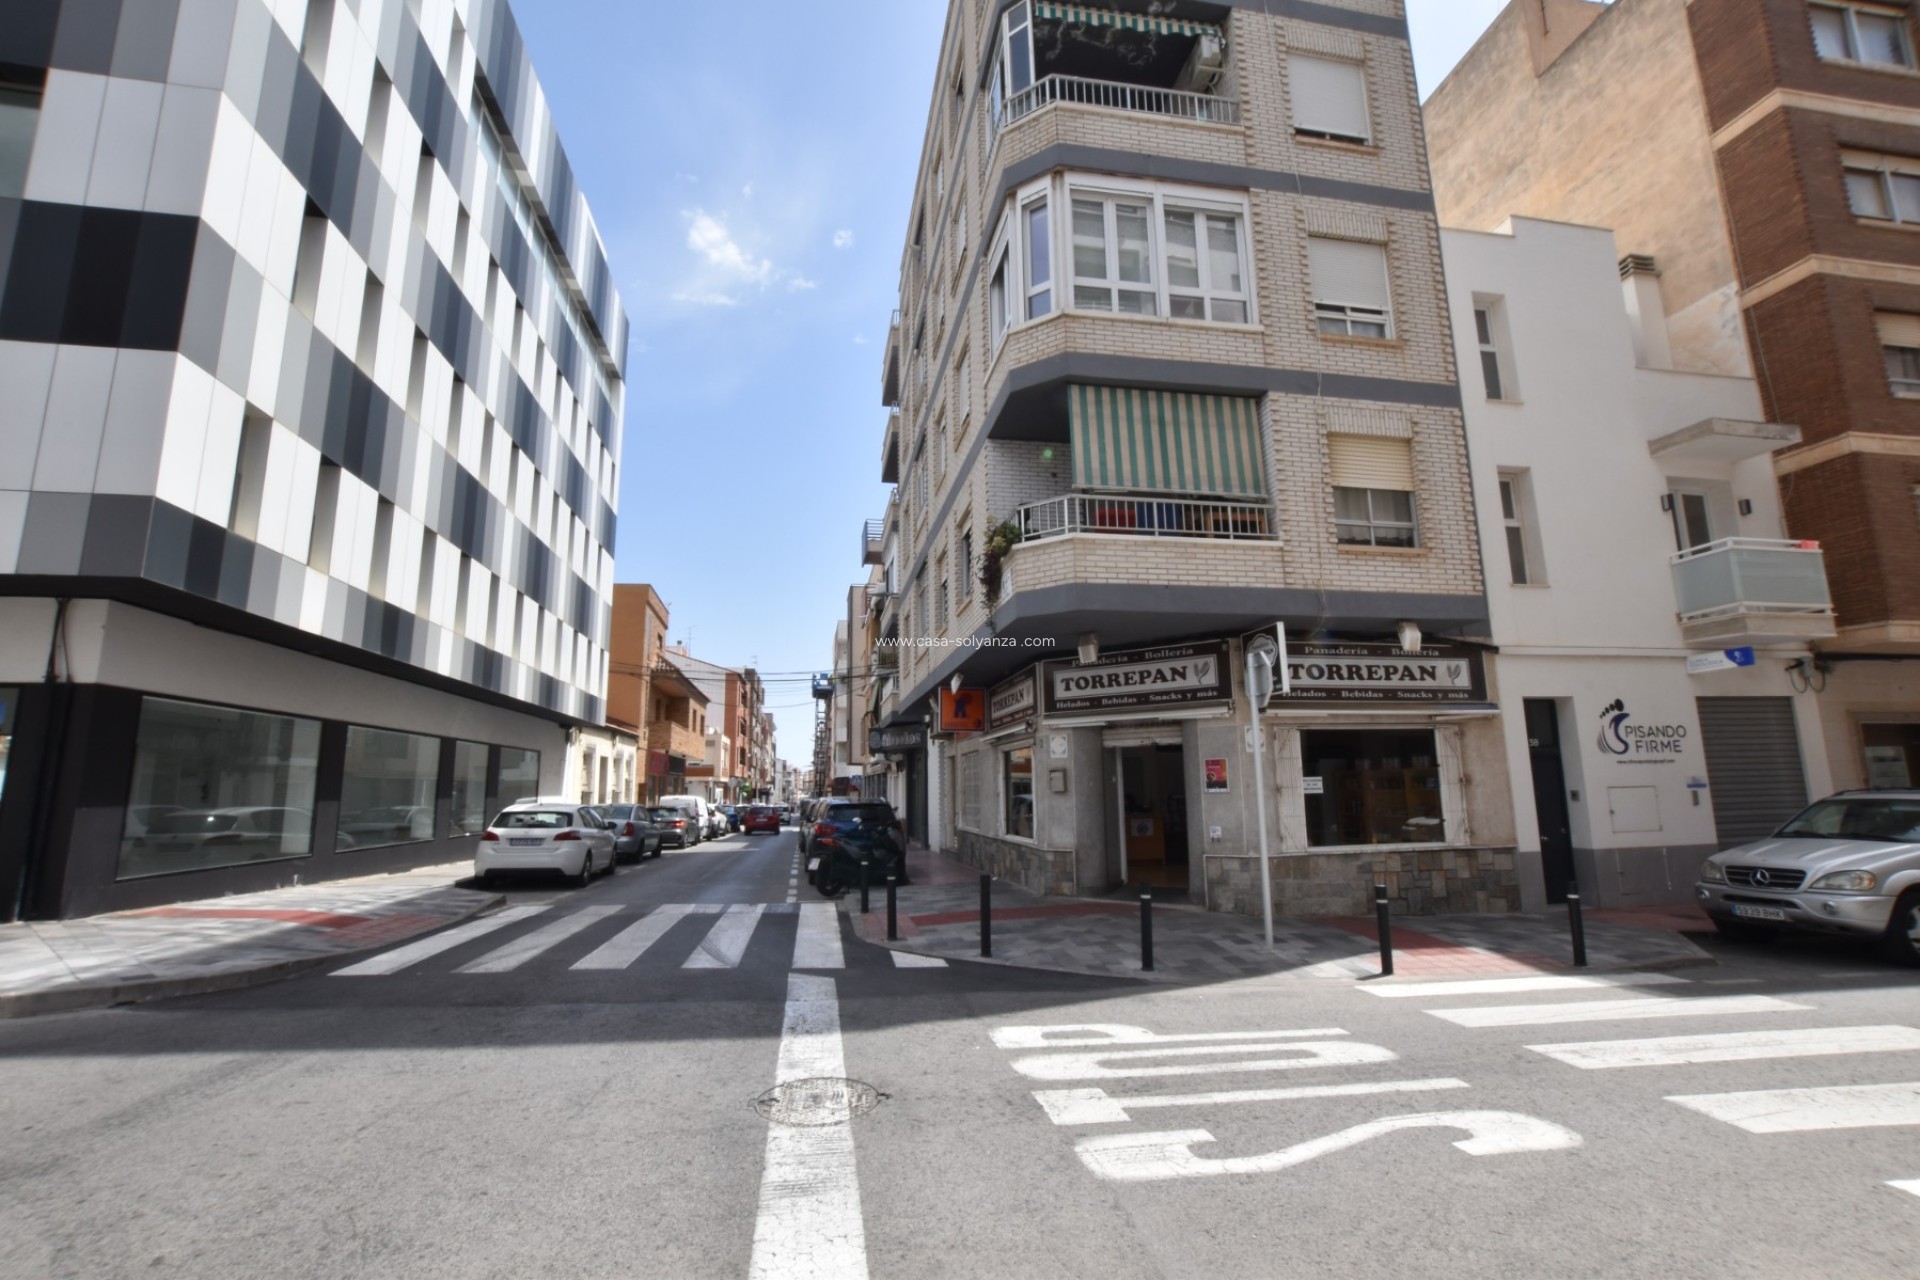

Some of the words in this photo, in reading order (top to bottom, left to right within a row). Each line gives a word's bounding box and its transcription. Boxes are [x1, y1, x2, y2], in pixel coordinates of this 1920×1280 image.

[1144, 647, 1194, 659] Bollería
[1304, 646, 1368, 655] Panadería
[1060, 665, 1188, 692] TORREPAN
[1287, 663, 1437, 681] TORREPAN
[1056, 699, 1090, 709] Helados
[1102, 696, 1137, 706] Bebidas
[1149, 692, 1182, 701] Snacks
[1186, 692, 1193, 700] y
[1197, 689, 1218, 698] más
[1341, 690, 1383, 698] Bebidas
[1396, 690, 1433, 698] Snacks
[1437, 692, 1443, 700] y
[1448, 690, 1469, 699] más
[1624, 725, 1687, 738] PISANDO
[1635, 739, 1683, 753] FIRME
[988, 1023, 1584, 1182] STOP
